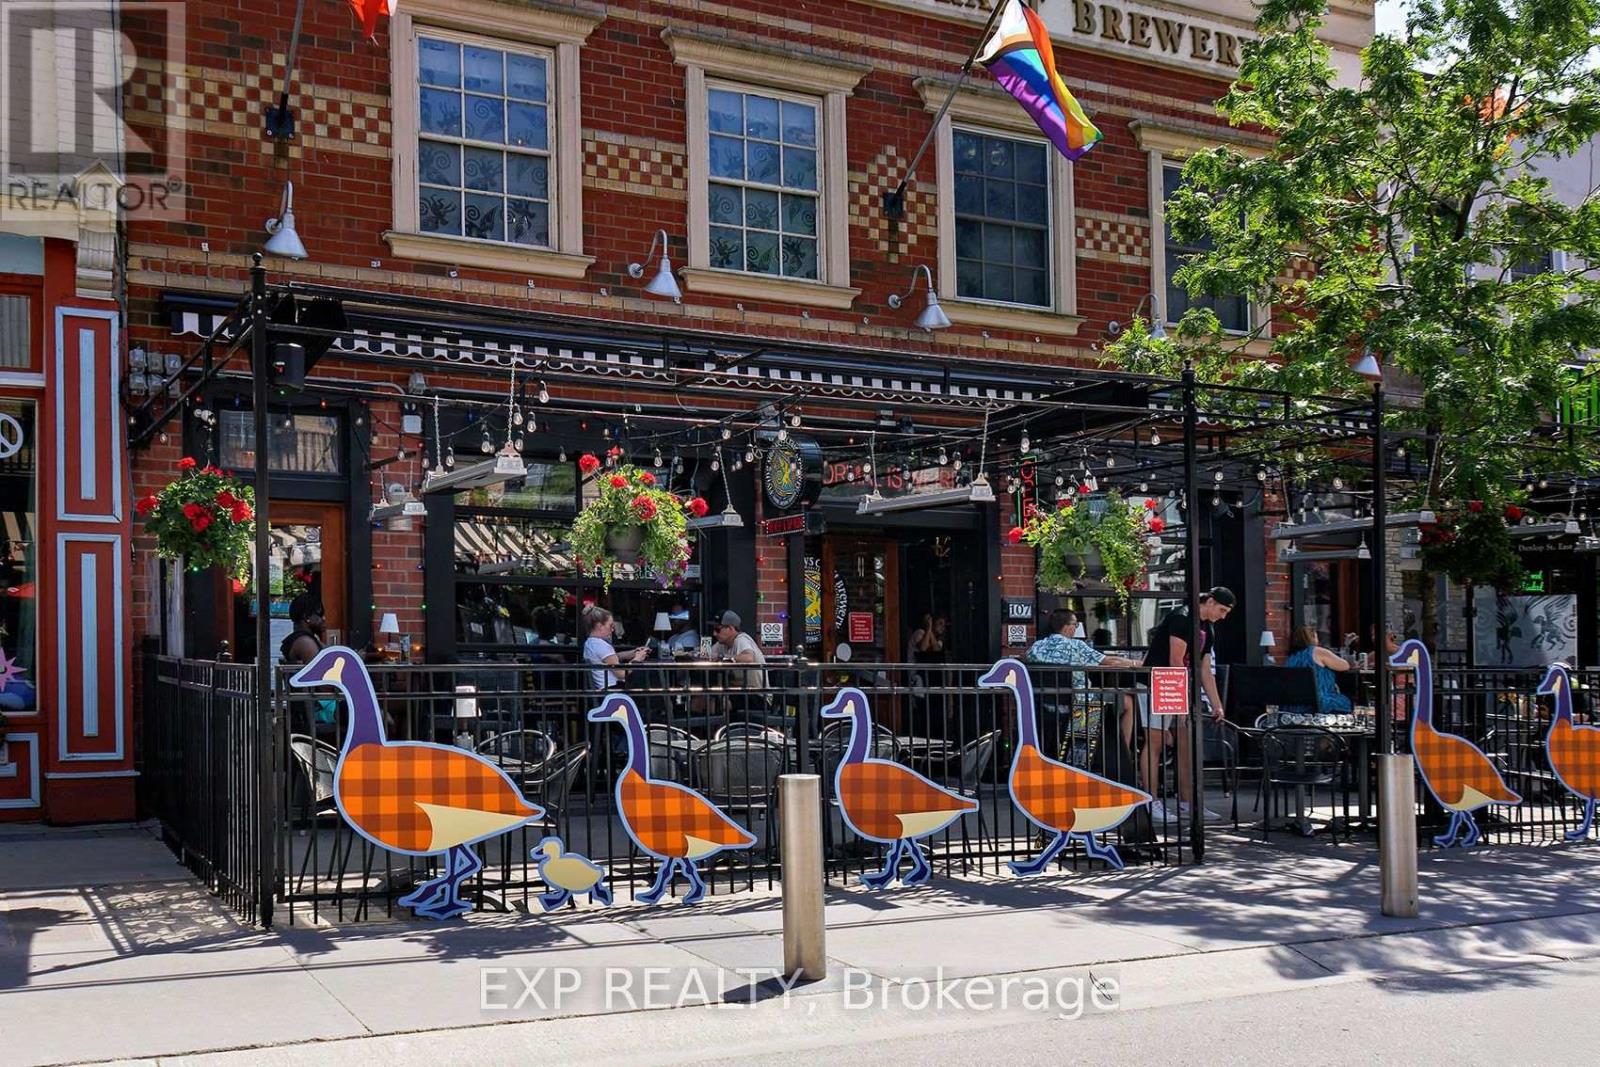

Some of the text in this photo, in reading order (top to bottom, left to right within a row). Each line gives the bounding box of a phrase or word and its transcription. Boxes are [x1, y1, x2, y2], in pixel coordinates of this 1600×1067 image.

[1518, 544, 1544, 553] Dunlop
[1558, 542, 1573, 550] East
[1009, 603, 1032, 617] 107
